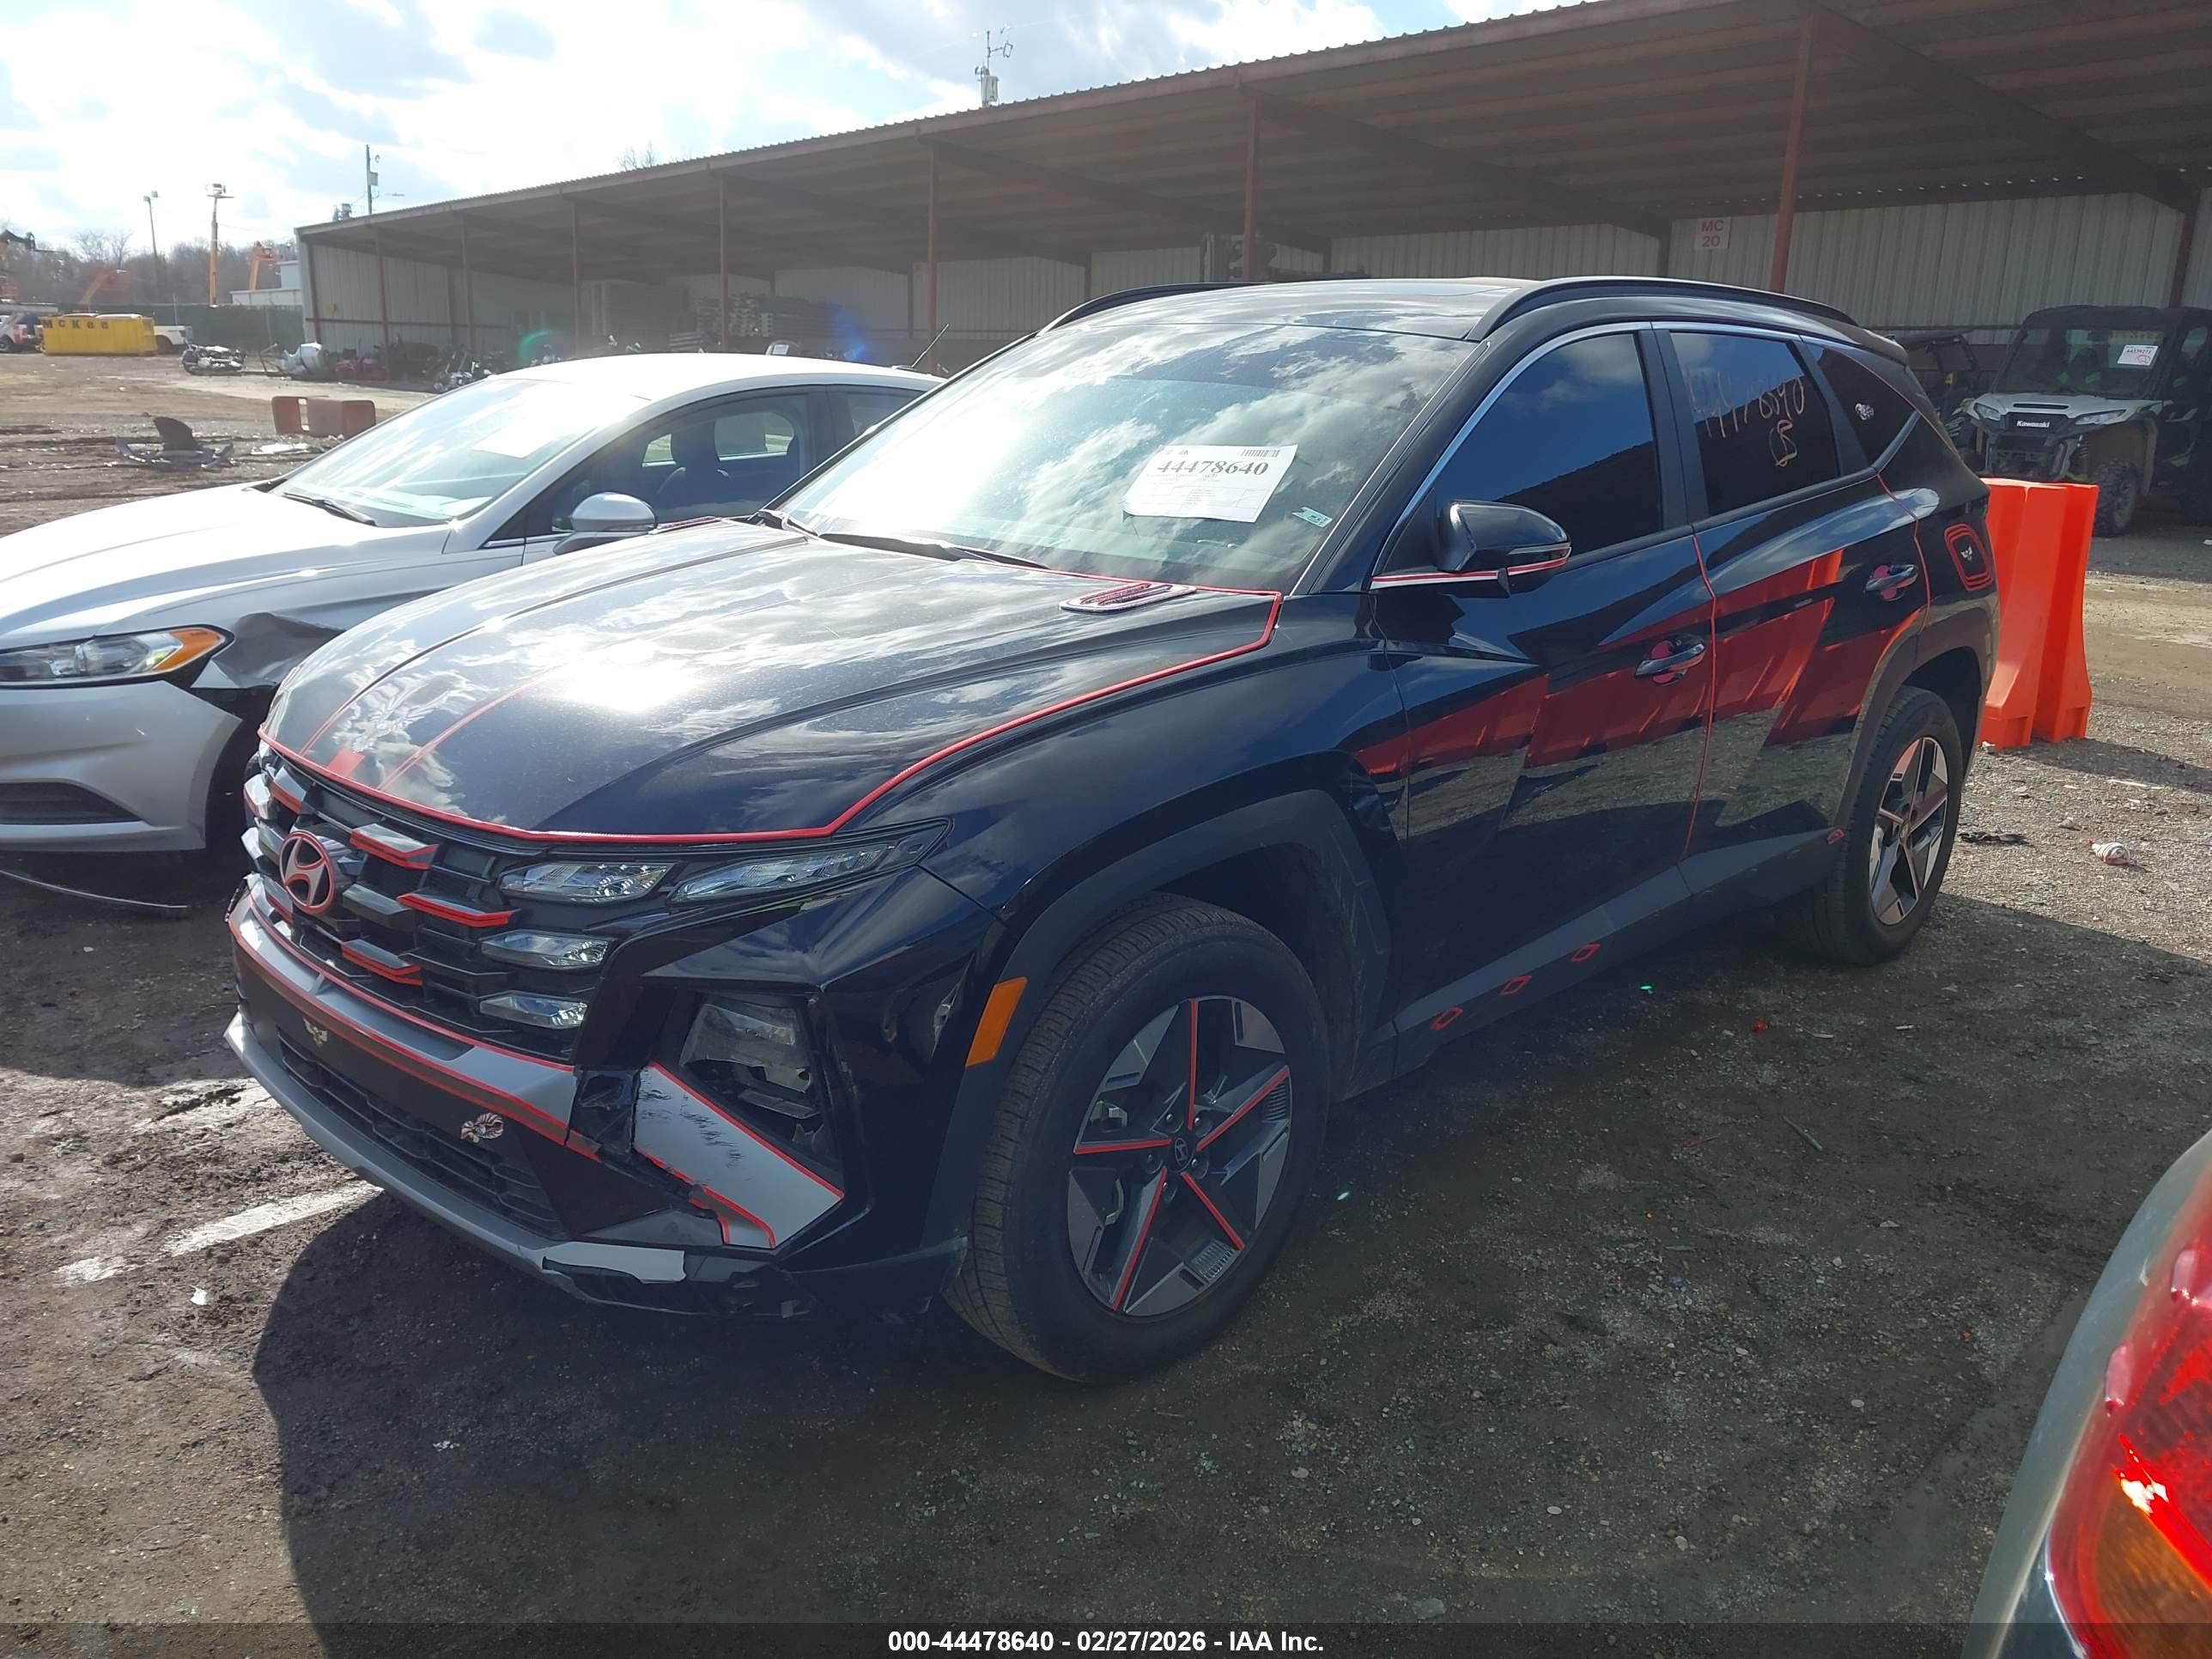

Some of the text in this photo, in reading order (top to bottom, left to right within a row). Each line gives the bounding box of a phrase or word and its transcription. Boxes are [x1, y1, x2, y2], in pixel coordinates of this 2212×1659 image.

[1701, 220, 1724, 232] MC
[1702, 235, 1721, 247] 20
[43, 319, 109, 330] McKee
[1157, 460, 1269, 476] 44478640
